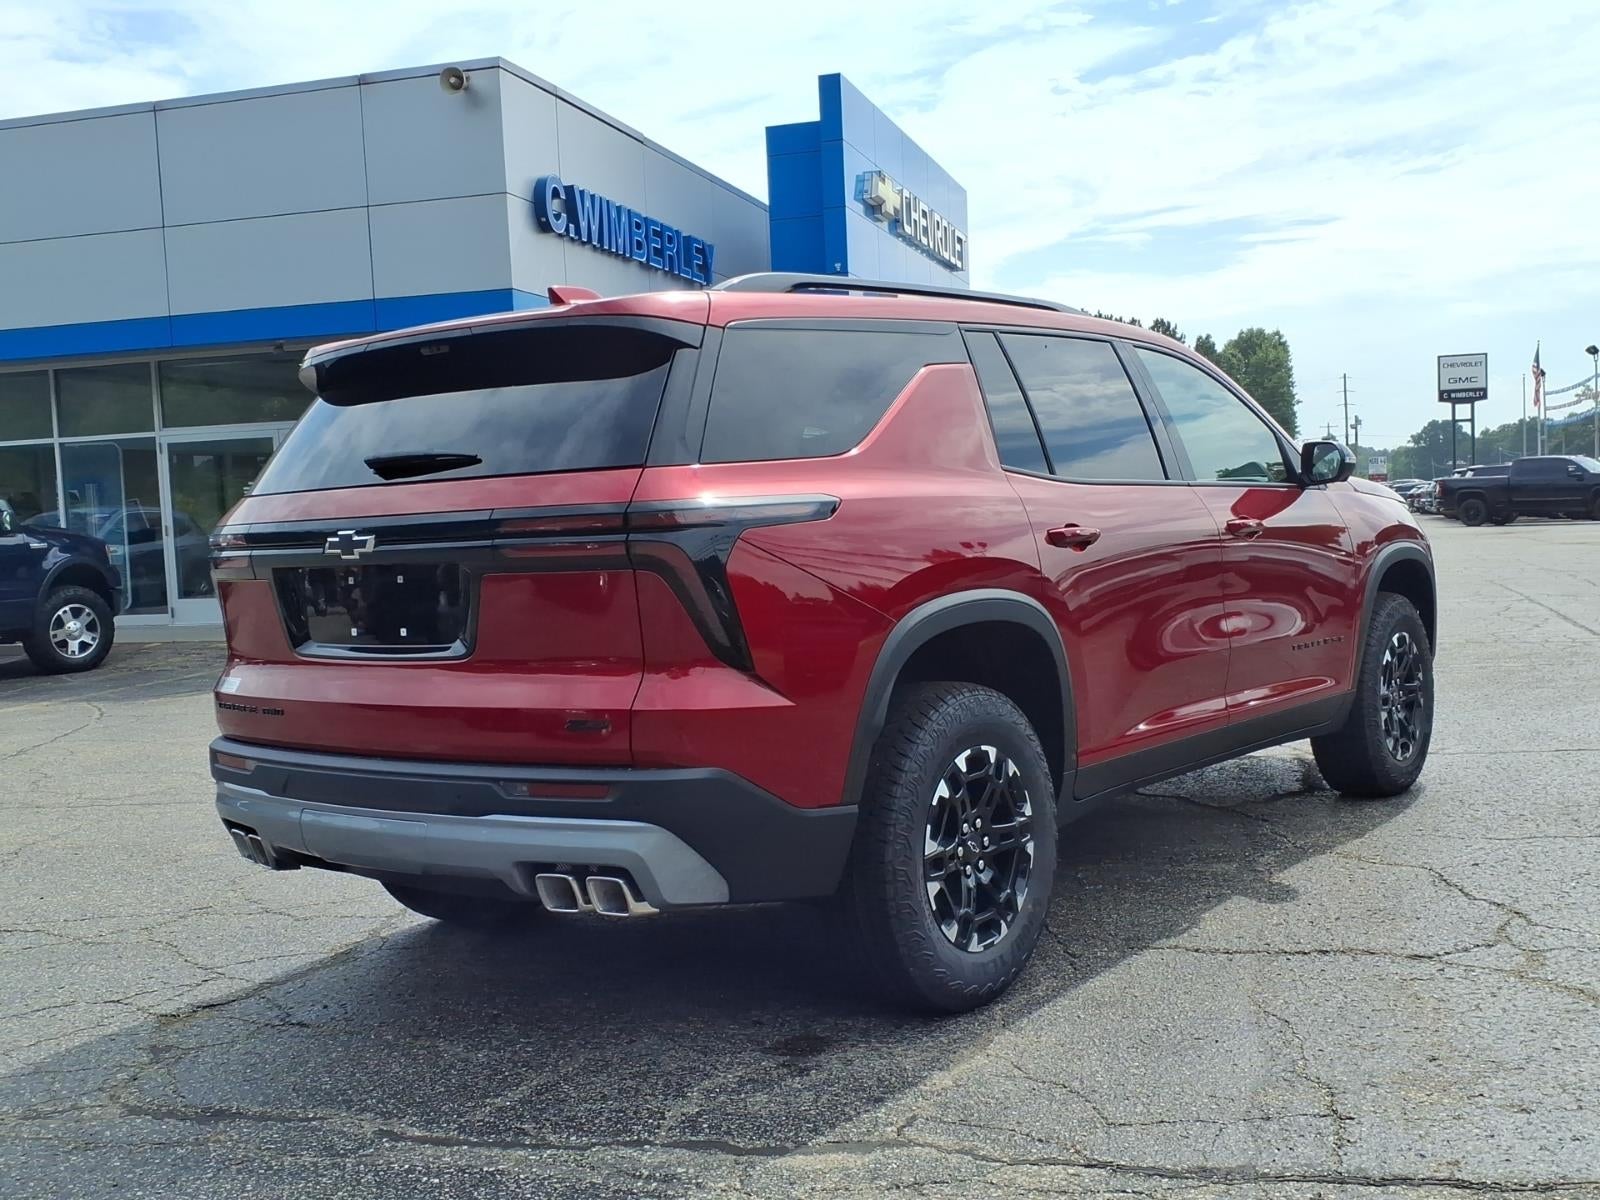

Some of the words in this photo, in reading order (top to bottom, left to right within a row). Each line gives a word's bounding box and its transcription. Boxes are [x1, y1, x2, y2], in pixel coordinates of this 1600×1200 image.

[901, 187, 967, 271] CHEVROLET
[1442, 361, 1483, 369] CHEVROLET
[1448, 376, 1479, 384] GMC
